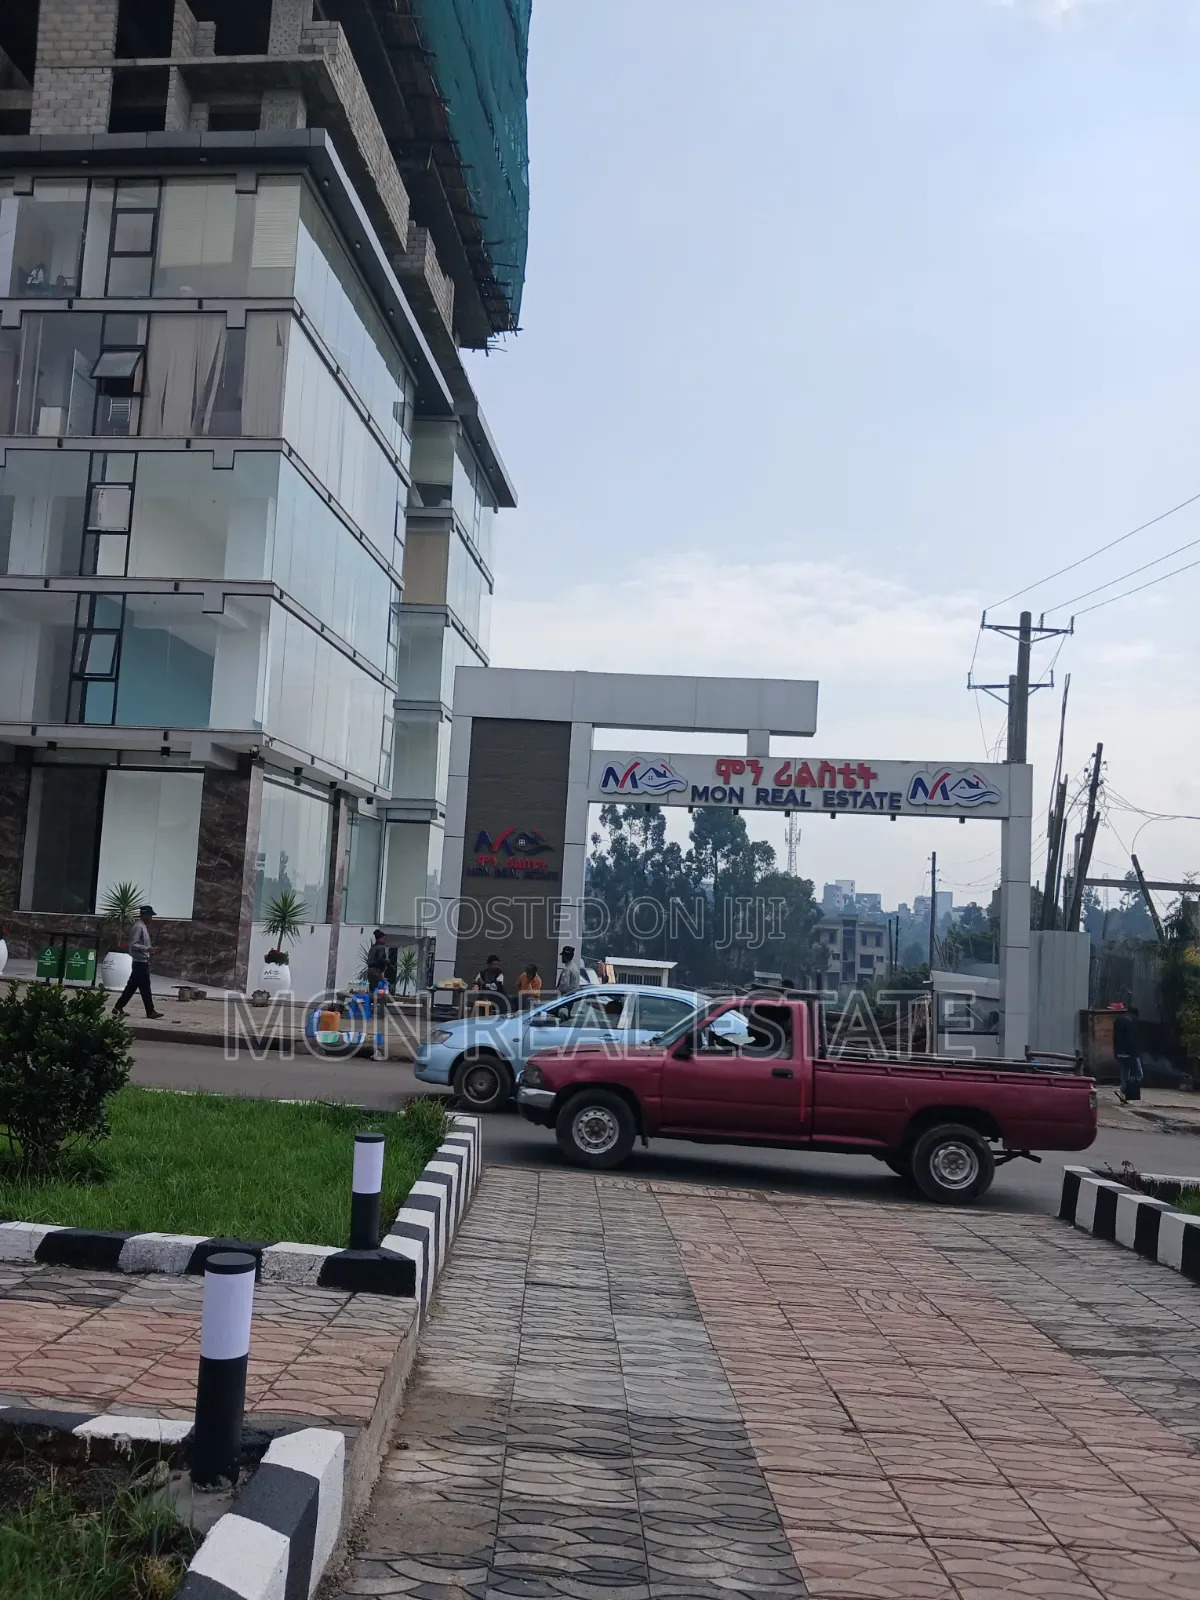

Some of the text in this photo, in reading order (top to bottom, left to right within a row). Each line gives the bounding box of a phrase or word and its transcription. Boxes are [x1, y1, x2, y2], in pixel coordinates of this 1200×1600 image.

[691, 785, 903, 811] MON REAL ESTATE
